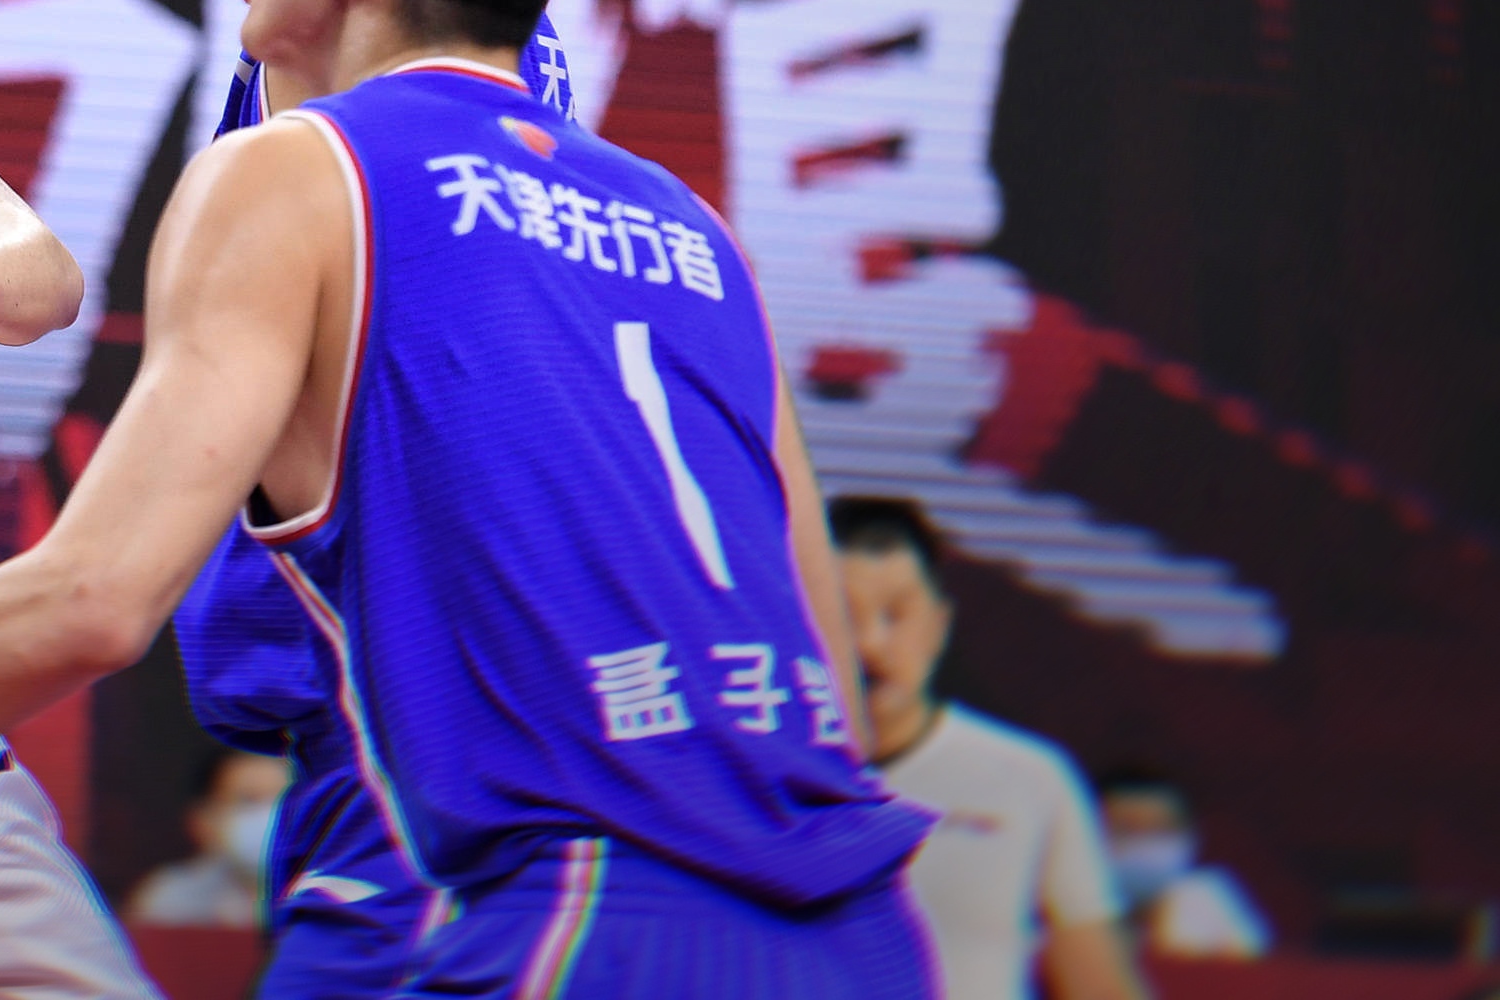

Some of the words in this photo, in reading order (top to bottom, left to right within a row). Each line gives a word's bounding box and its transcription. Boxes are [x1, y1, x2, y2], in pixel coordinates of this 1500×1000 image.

[535, 33, 580, 122] 天
[425, 153, 725, 302] 天津先行者
[614, 321, 735, 590] 1
